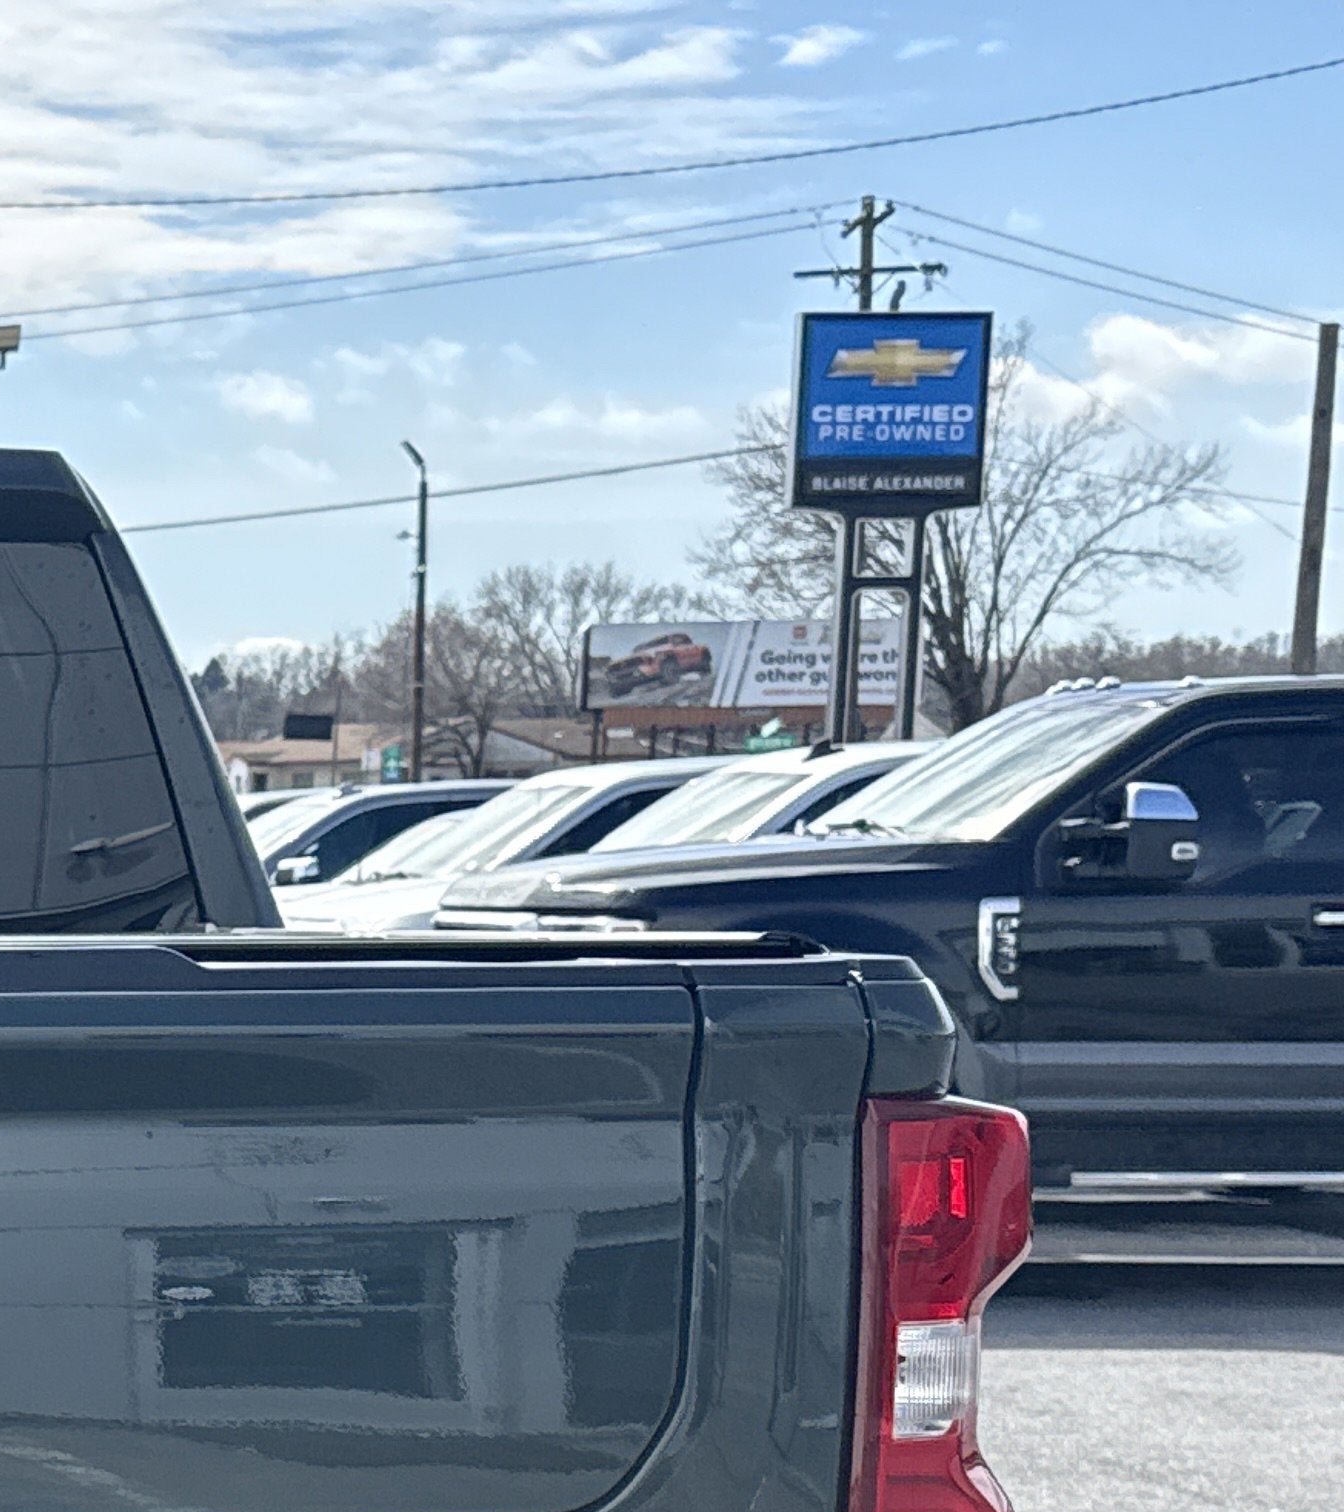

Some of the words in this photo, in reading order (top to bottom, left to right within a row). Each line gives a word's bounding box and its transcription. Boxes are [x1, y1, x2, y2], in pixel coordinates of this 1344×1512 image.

[811, 403, 974, 423] CERTIFIED
[818, 425, 965, 441] PRE-OWNED
[811, 475, 868, 491] BLAISE
[873, 474, 966, 491] ALEXANDER
[760, 649, 817, 668] Going
[821, 652, 878, 663] wre
[882, 648, 899, 663] th
[755, 668, 806, 683] other
